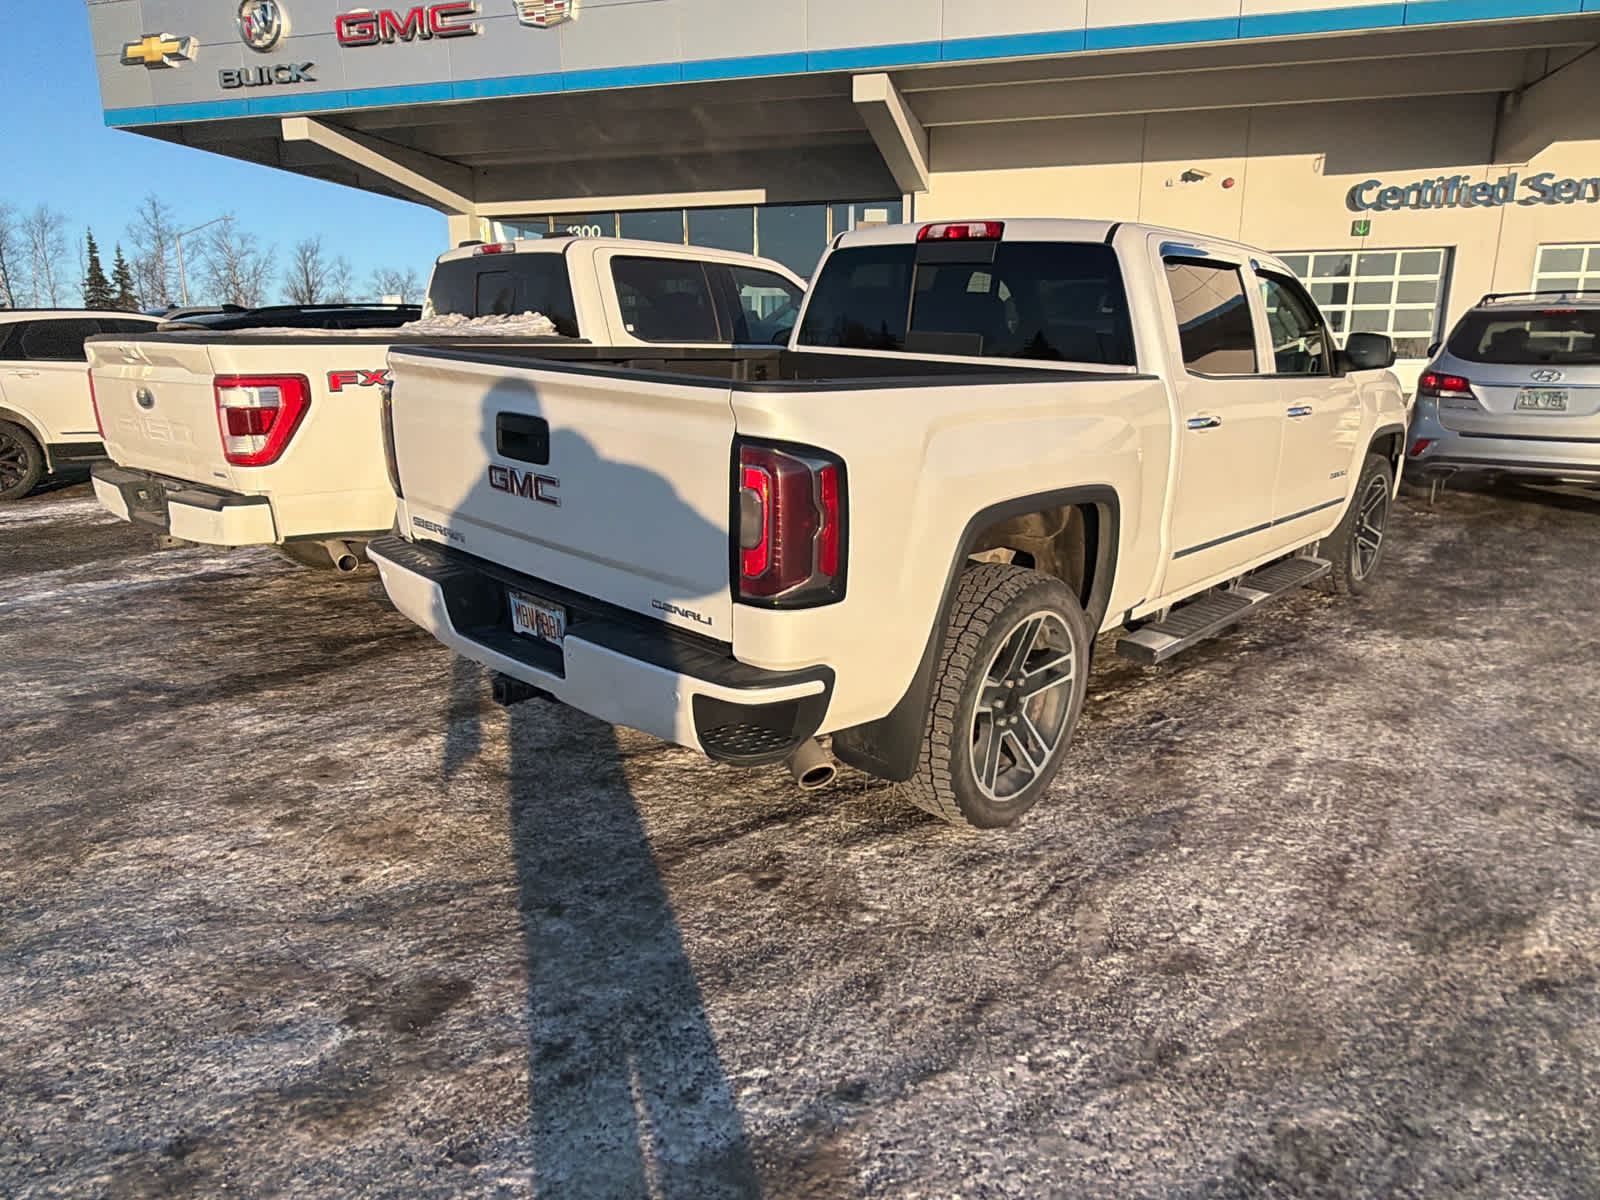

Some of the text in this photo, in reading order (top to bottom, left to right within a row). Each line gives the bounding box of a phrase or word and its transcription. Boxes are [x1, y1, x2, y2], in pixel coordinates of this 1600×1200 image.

[335, 1, 478, 47] GMC
[218, 61, 317, 88] BUICK
[1347, 172, 1600, 211] Certified Ser
[566, 224, 602, 239] 1300
[488, 464, 561, 507] GMC
[412, 516, 466, 544] SIERRA
[651, 599, 713, 626] DENALI
